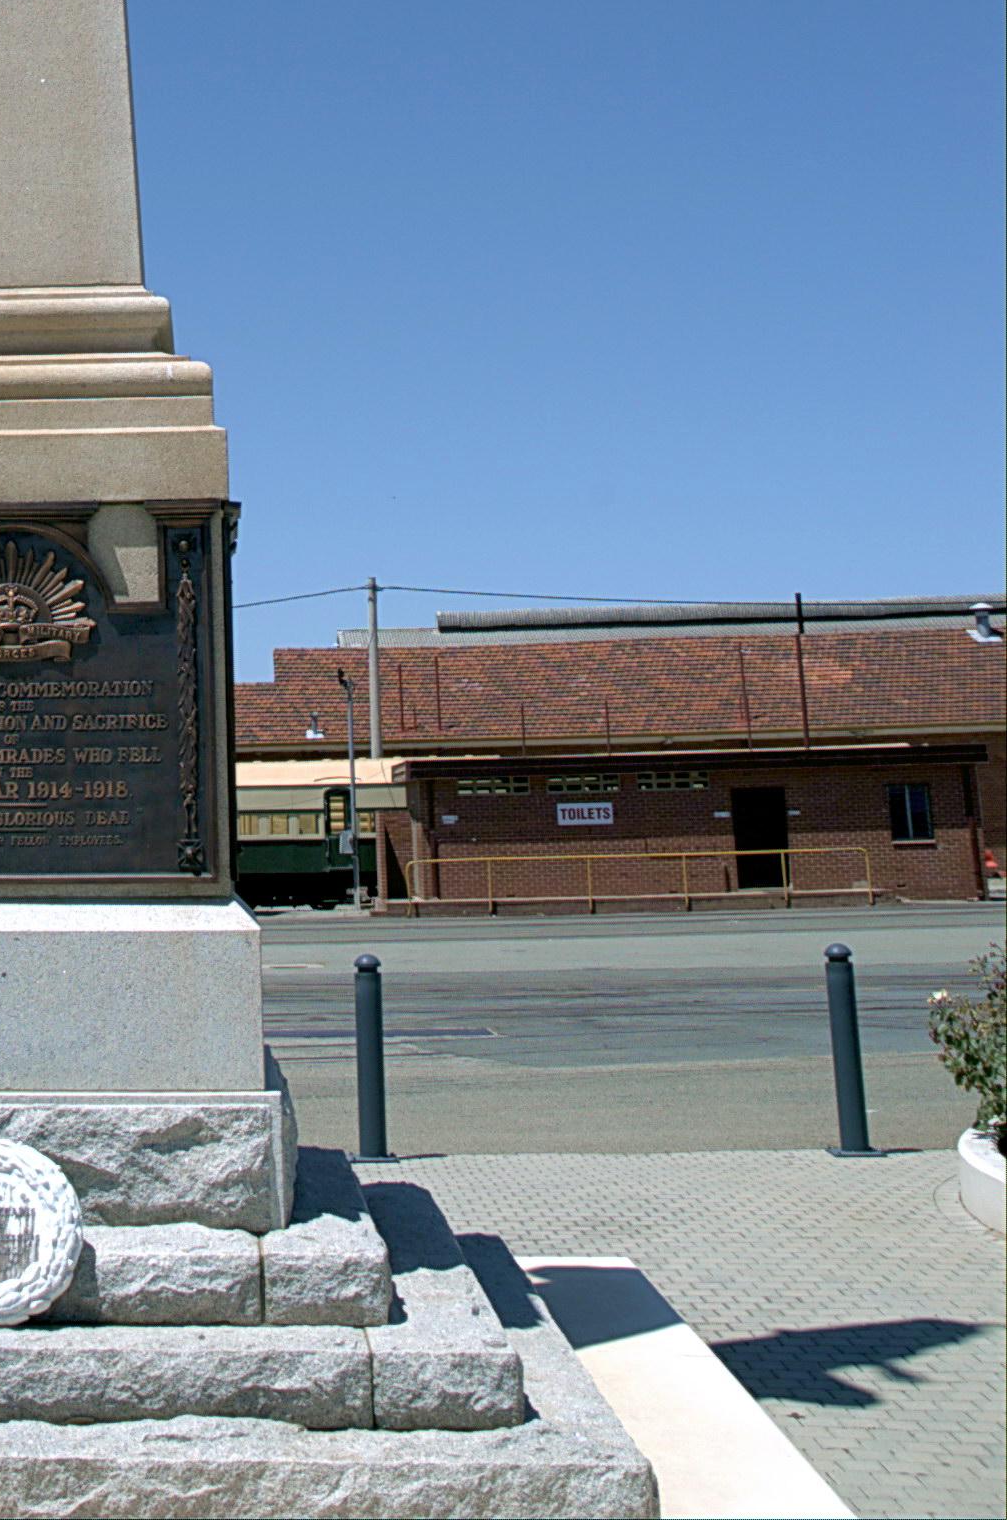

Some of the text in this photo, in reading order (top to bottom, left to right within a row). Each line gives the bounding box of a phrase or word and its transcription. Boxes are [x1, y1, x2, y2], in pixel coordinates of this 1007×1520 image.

[27, 627, 82, 641] MILITARY
[10, 701, 35, 712] THE
[31, 715, 67, 731] AND
[71, 714, 170, 730] SACRIFICE
[3, 734, 20, 745] OF
[73, 748, 113, 764] WHO
[117, 747, 163, 763] FELL
[9, 767, 34, 778] THE
[560, 807, 611, 820] TOILETS
[10, 835, 51, 847] FELLOW
